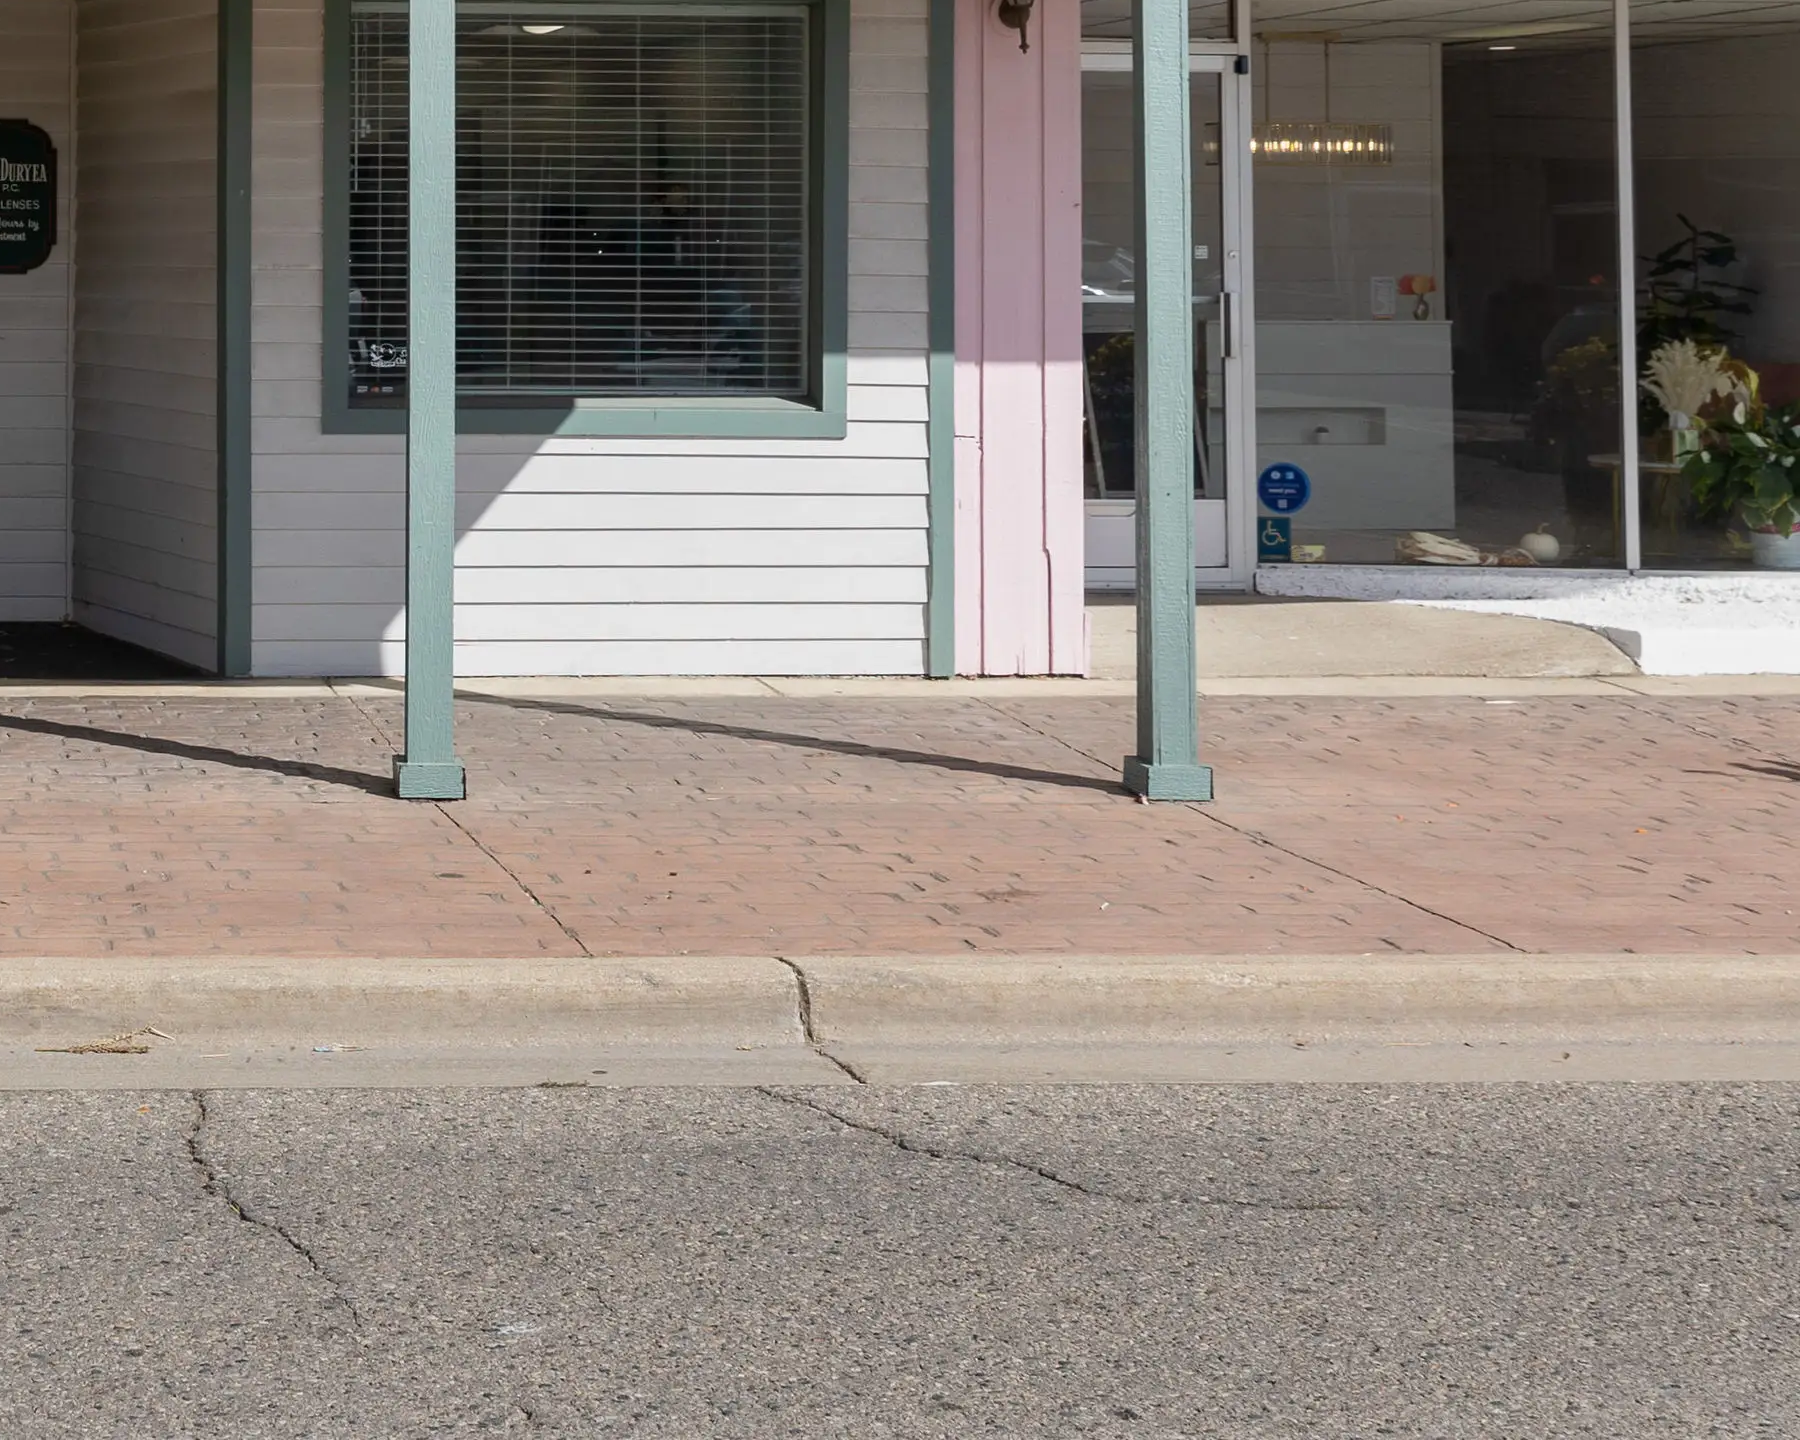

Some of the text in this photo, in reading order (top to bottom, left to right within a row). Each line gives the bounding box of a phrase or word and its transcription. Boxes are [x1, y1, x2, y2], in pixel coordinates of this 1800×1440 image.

[0, 157, 48, 183] DURYEA
[0, 199, 40, 210] LENSES
[28, 218, 40, 231] by
